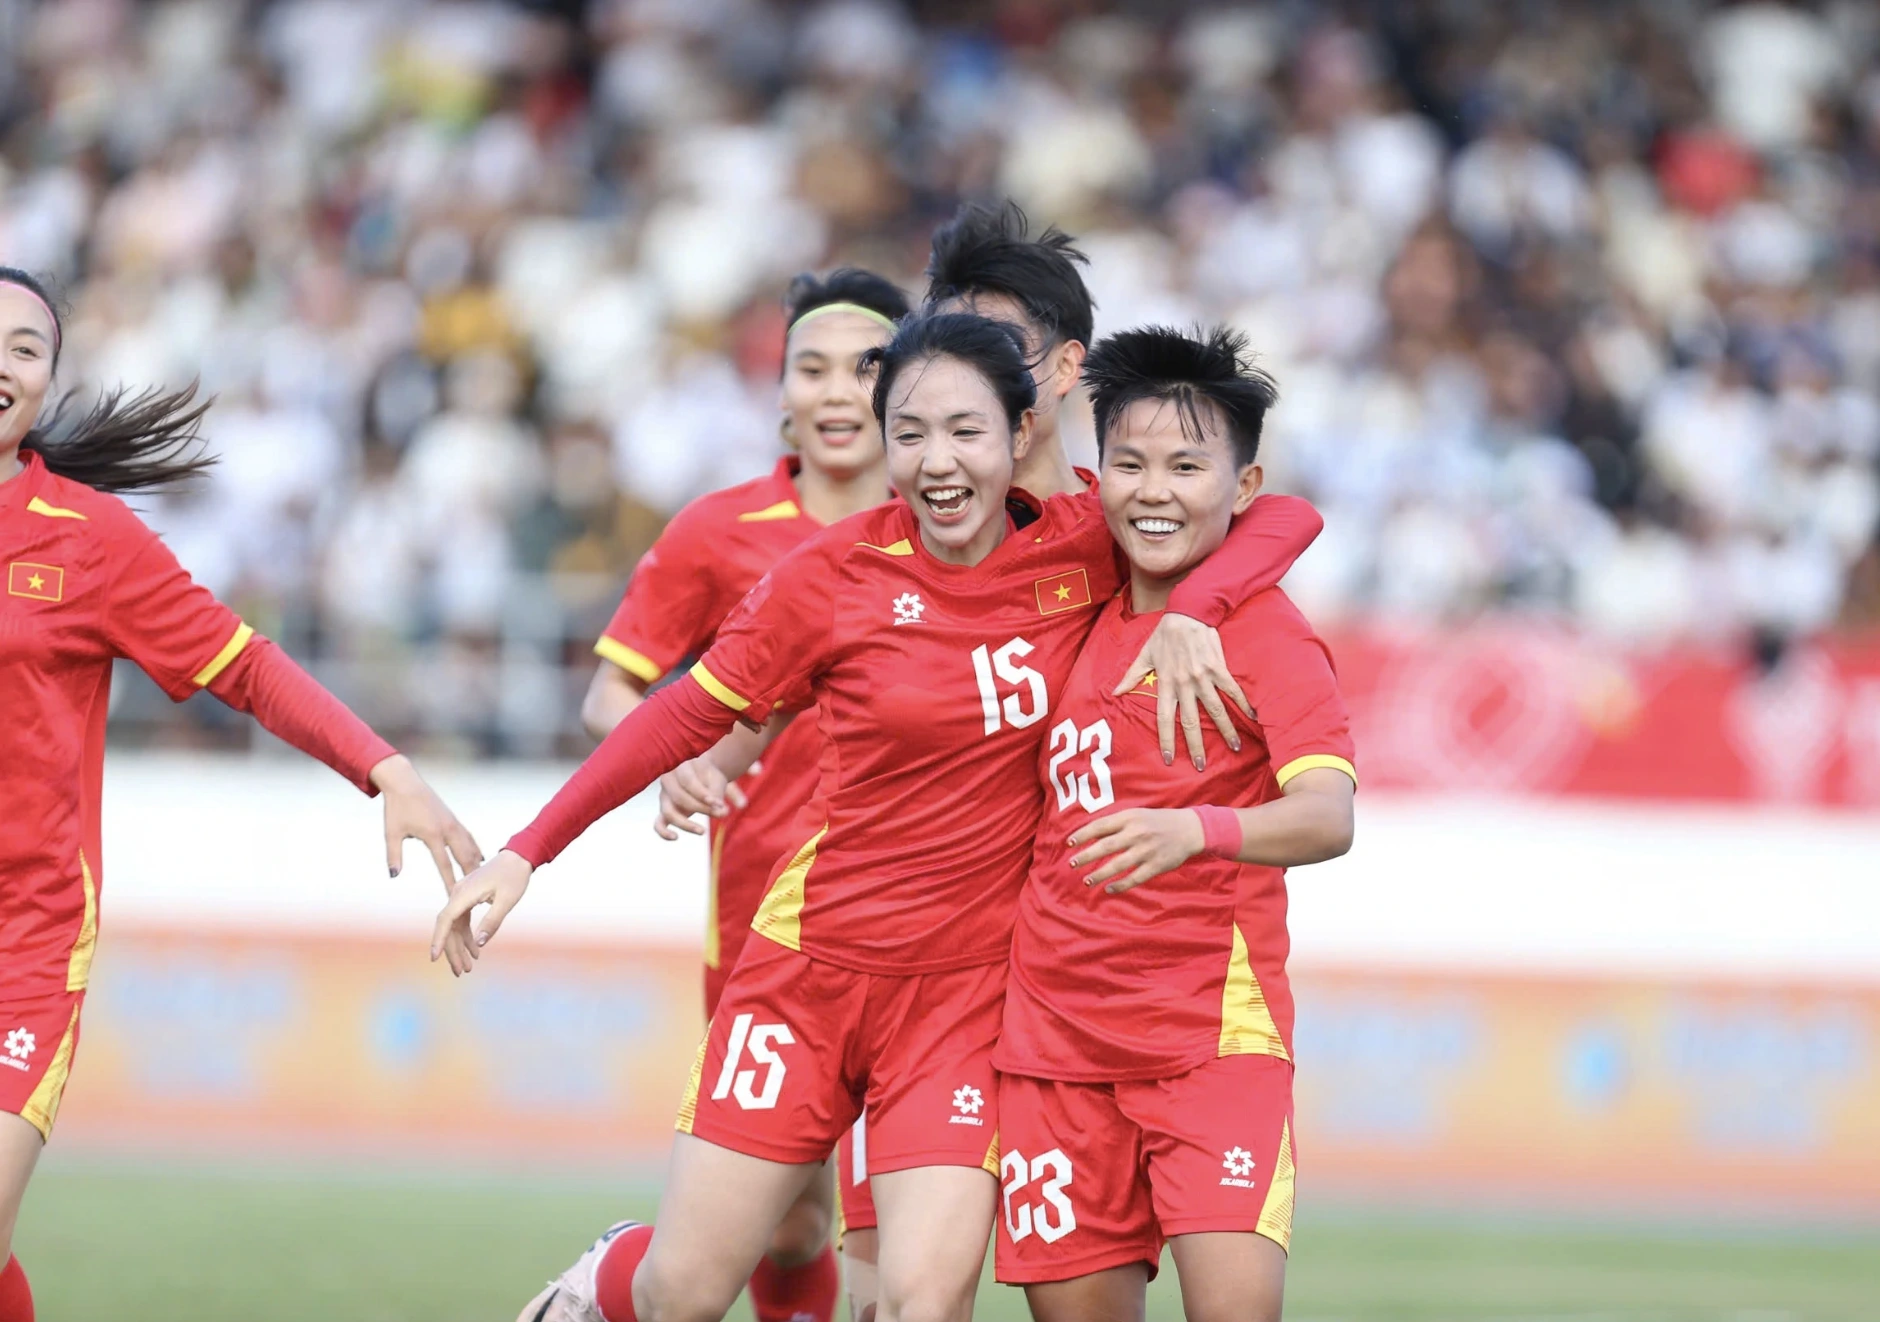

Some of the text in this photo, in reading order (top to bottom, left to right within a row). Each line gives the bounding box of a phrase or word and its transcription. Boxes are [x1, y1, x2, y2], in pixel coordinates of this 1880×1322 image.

[972, 637, 1048, 736] 15
[1049, 718, 1115, 814] 23
[711, 1013, 796, 1111] 15
[1000, 1148, 1077, 1245] 23
